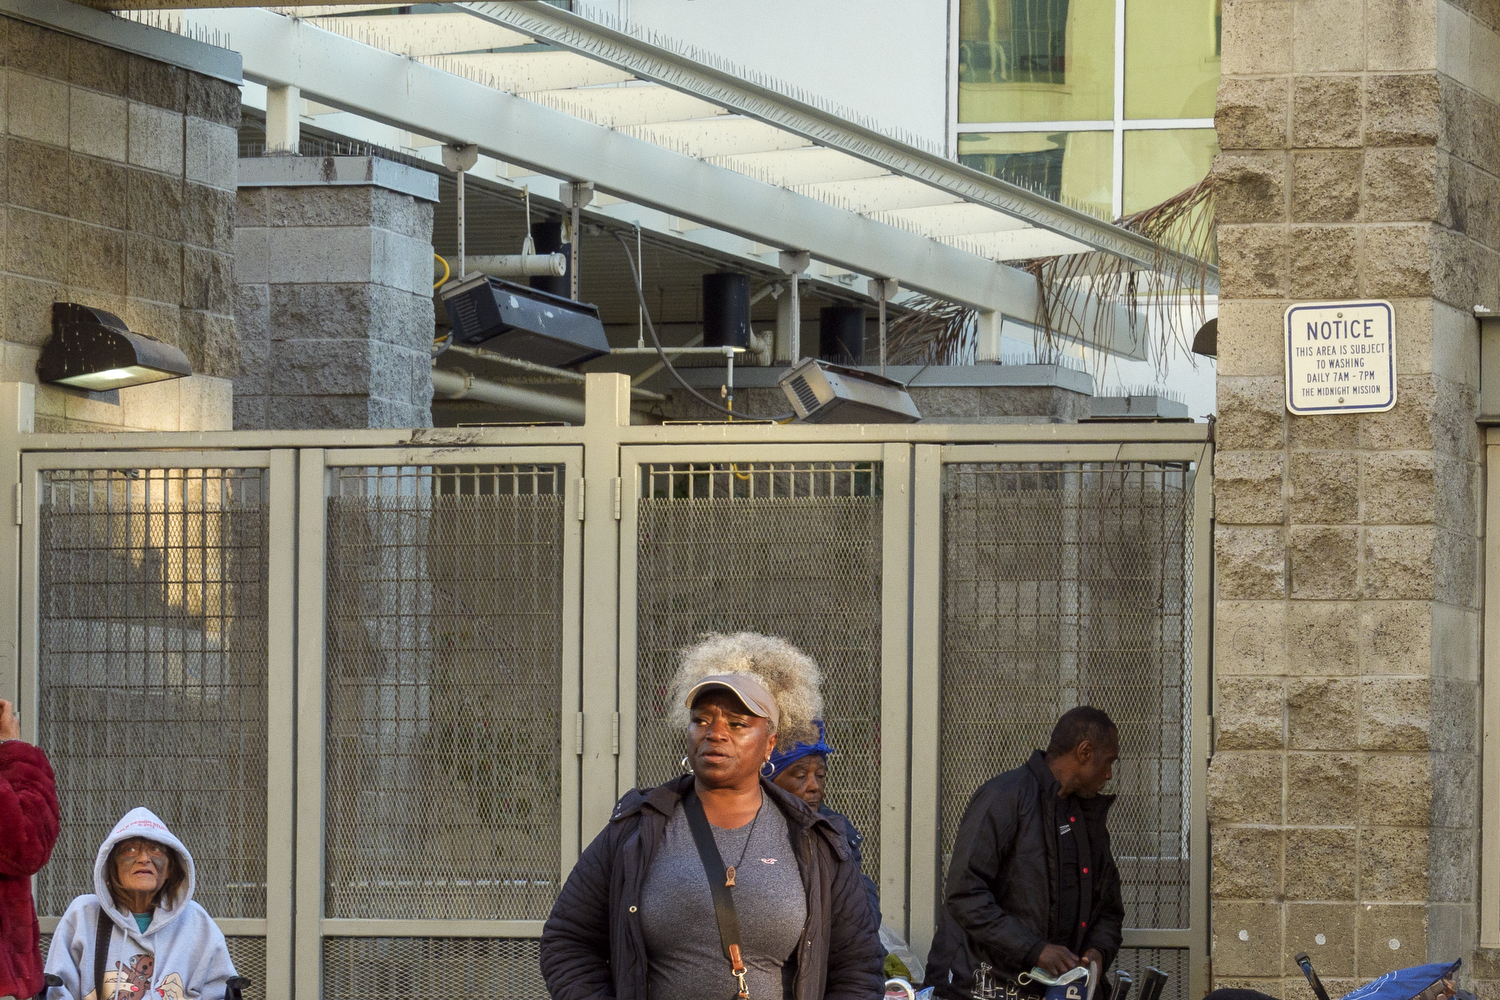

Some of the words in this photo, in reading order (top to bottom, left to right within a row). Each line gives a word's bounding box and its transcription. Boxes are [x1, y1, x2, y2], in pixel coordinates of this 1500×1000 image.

[1306, 319, 1374, 341] NOTICE
[1295, 346, 1313, 357] THIS
[1316, 345, 1337, 356] AREA
[1339, 344, 1348, 355] IS
[1350, 342, 1385, 355] SUBJECT
[1316, 359, 1326, 369] TO
[1328, 357, 1365, 369] WASHING
[1306, 372, 1331, 383] DAILY
[1333, 371, 1350, 382] 7AM
[1359, 370, 1375, 381] 7PM
[1301, 387, 1315, 397] THE
[1317, 386, 1350, 396] MIDNIGHT
[1352, 384, 1381, 395] MISSION
